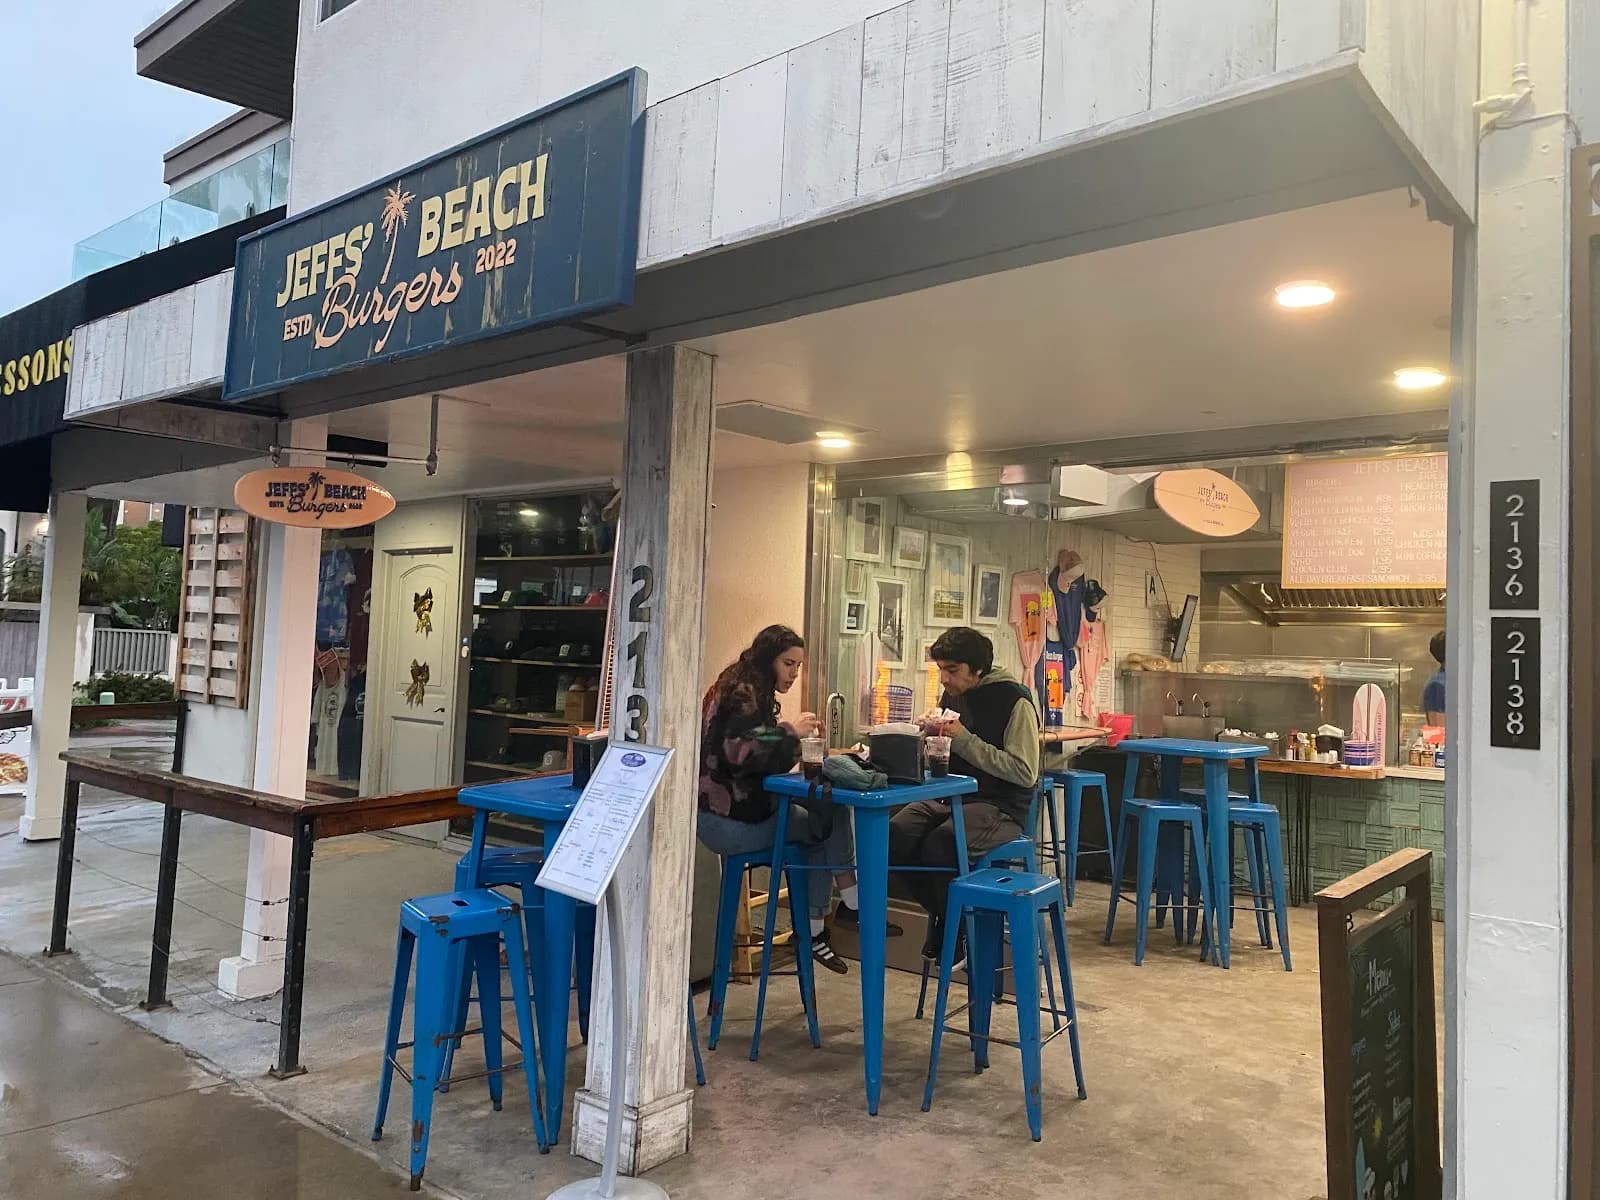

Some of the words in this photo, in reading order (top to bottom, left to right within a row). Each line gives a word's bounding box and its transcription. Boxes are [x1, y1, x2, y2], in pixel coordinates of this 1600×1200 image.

[417, 153, 549, 258] BEACH
[283, 313, 313, 341] ESTD
[314, 262, 463, 353] Burgers
[475, 238, 517, 275] 2022
[0, 336, 72, 395] SSONS
[324, 484, 366, 500] BEACH
[1396, 457, 1439, 473] BEACH
[287, 495, 347, 519] Burgers
[1505, 494, 1525, 597] 2136
[1149, 575, 1156, 595] A
[1506, 631, 1526, 735] 2138
